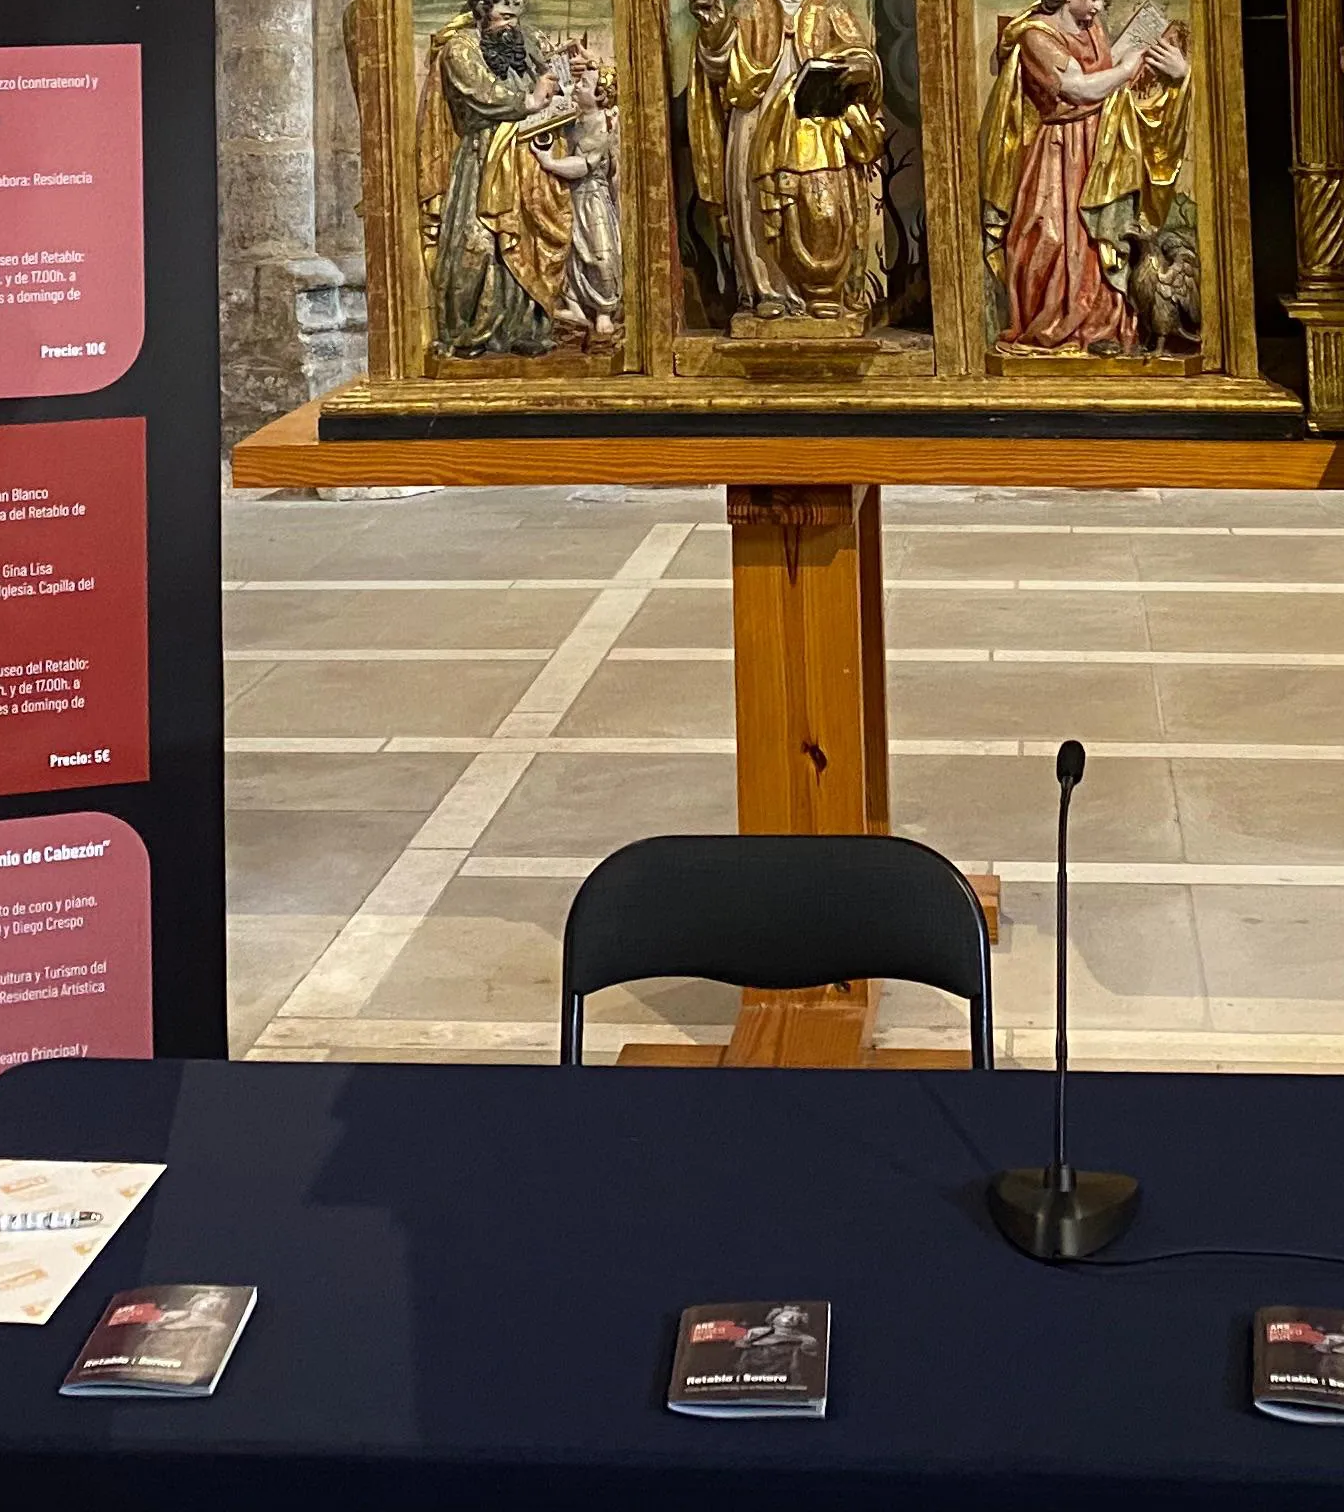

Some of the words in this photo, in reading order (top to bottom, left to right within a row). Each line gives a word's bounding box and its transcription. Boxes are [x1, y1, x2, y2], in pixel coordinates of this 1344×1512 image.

[17, 75, 90, 89] (contratenor)
[92, 77, 98, 89] y
[33, 172, 93, 185] Residencia
[22, 252, 38, 265] del
[41, 251, 85, 263] Retablo:
[41, 344, 83, 358] Precio:
[85, 342, 106, 355] 10€
[12, 488, 48, 501] Blanco
[9, 507, 26, 520] del
[28, 505, 69, 518] Retablo
[72, 503, 86, 516] de
[50, 752, 92, 767] Precio:
[94, 749, 110, 763] 5€
[23, 849, 41, 864] de
[12, 903, 26, 915] de
[28, 902, 53, 913] coro
[56, 901, 62, 913] y
